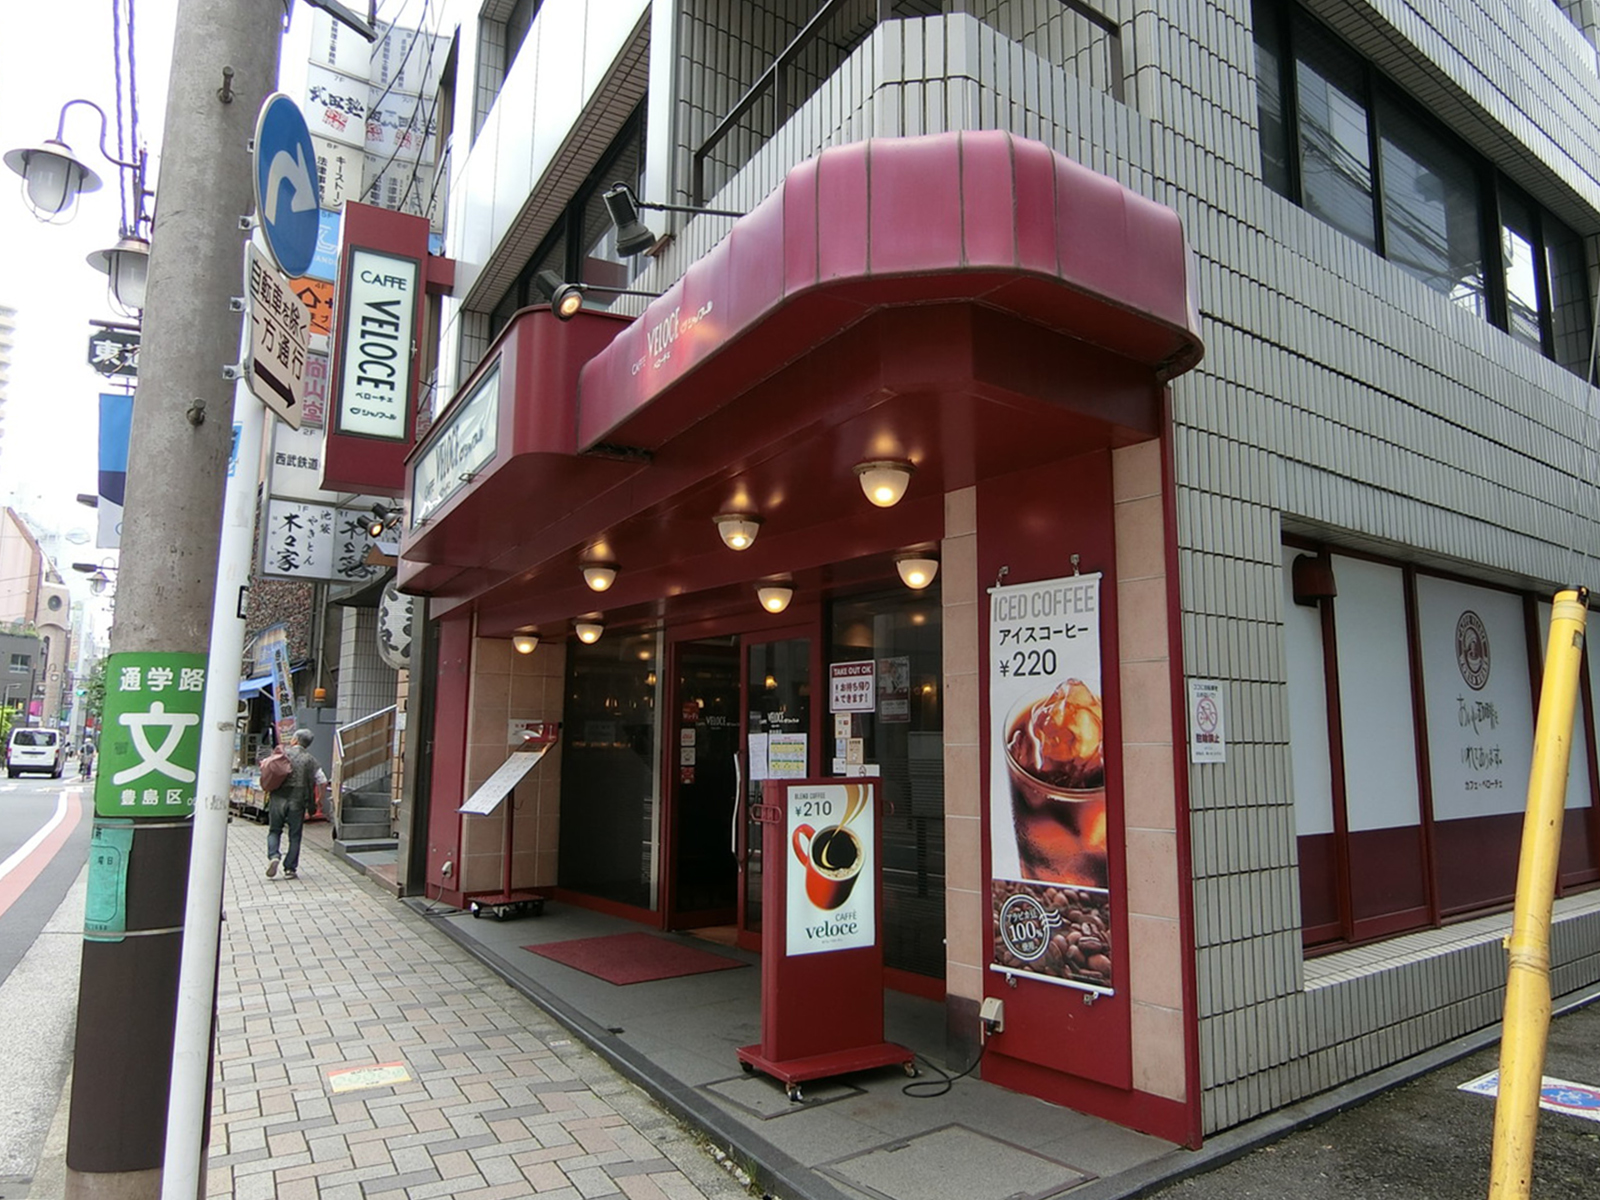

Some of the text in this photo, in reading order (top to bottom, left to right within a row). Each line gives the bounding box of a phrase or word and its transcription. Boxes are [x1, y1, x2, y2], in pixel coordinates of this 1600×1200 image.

[309, 86, 364, 119] 武田塾
[332, 156, 346, 207] キーストーン
[321, 211, 333, 219] 5F
[315, 282, 326, 290] 4F
[251, 258, 307, 344] 自転車を除く
[647, 306, 680, 359] VELOCE
[251, 314, 304, 380] 一方通行
[356, 300, 401, 391] VELOCE
[355, 392, 394, 403] ベローチェ
[303, 428, 316, 436] 2F
[275, 452, 320, 471] 西武鉄道
[297, 505, 309, 513] 1F
[319, 510, 332, 534] 池袋
[276, 512, 303, 572] 木々家
[303, 516, 318, 565] やきとん
[993, 585, 1095, 622] ICED COFFEE
[999, 623, 1089, 646] アイスコーヒー
[833, 665, 872, 676] TAKE OUT OK
[999, 648, 1057, 678] ¥220
[119, 666, 205, 692] 通学路
[840, 681, 870, 692] お持ち帰り
[113, 701, 200, 785] 文
[120, 789, 184, 806] 豊島区
[795, 800, 832, 816] ¥210
[805, 920, 859, 939] veloce
[1009, 921, 1044, 942] 100%
